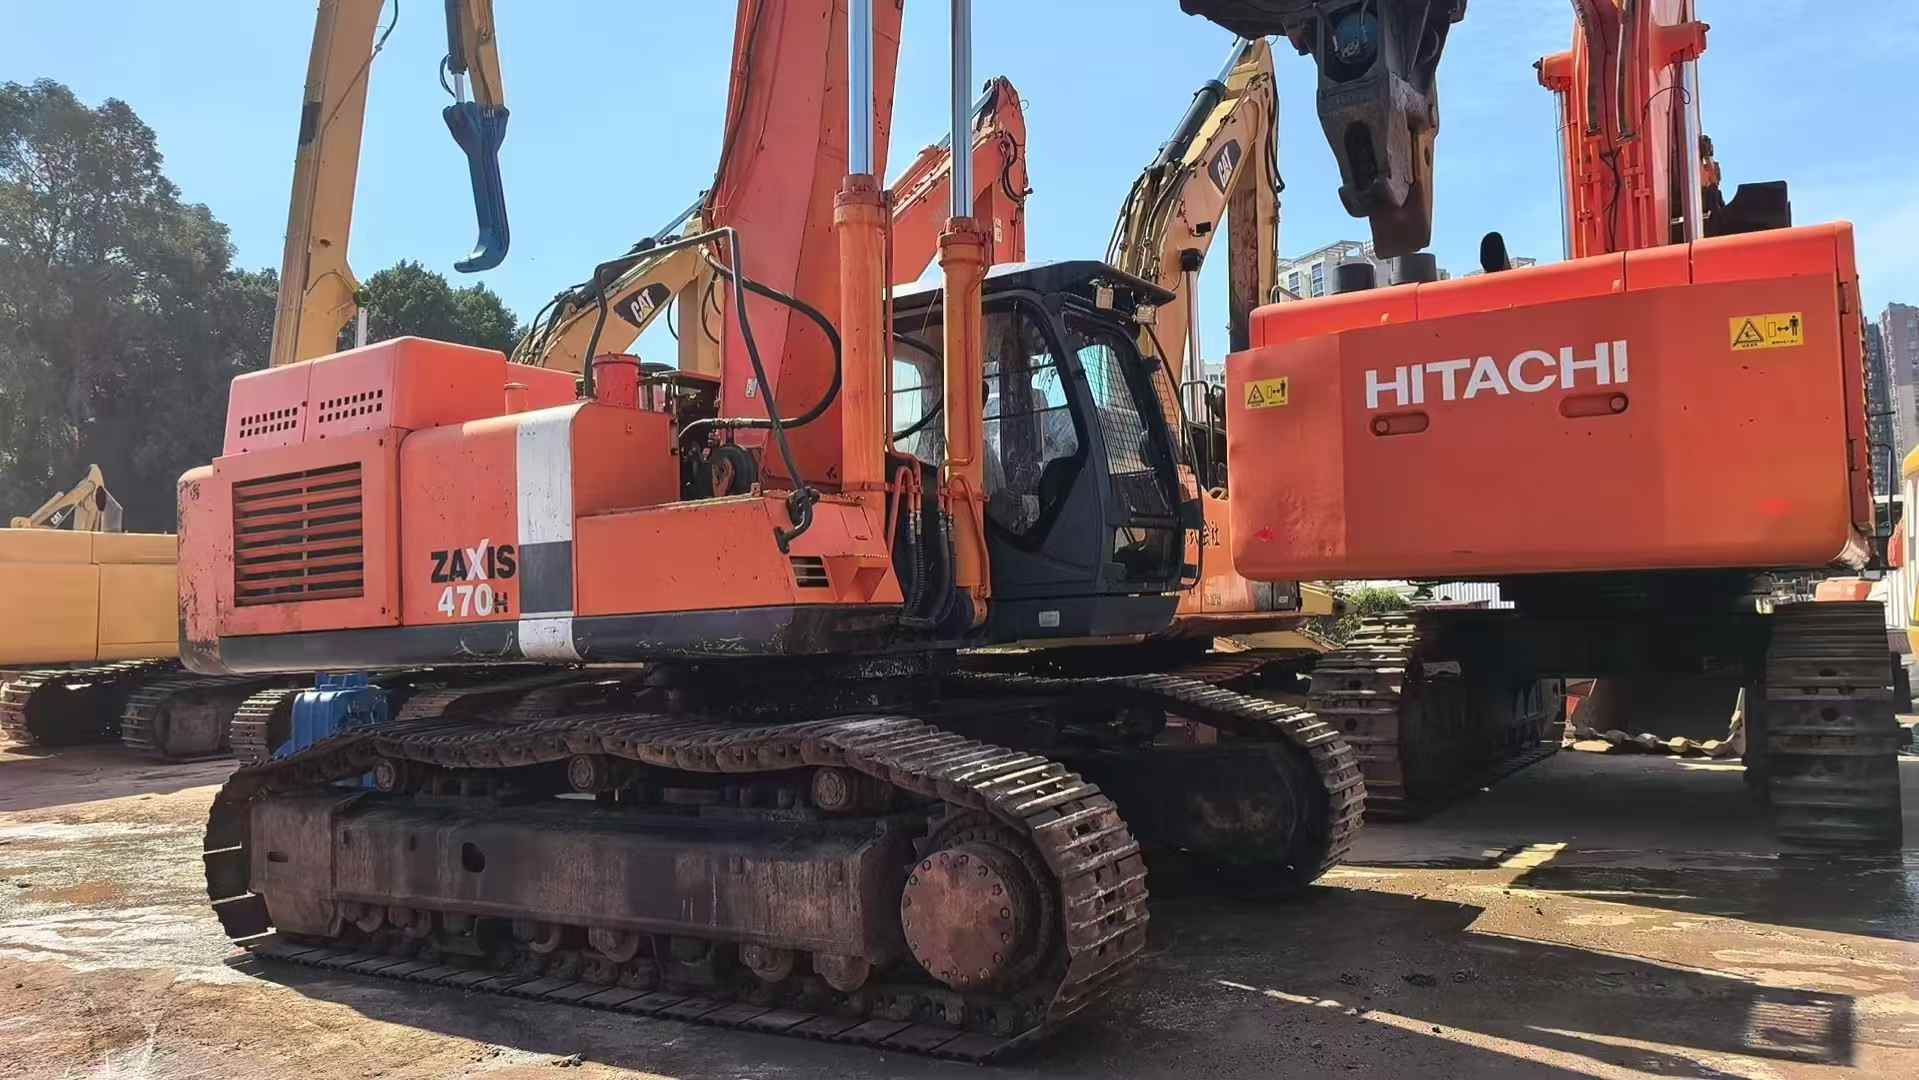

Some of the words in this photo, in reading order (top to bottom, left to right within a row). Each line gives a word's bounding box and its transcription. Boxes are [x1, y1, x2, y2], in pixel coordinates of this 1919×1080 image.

[1217, 145, 1233, 188] CAT
[630, 288, 656, 323] CAT
[1365, 340, 1629, 409] HITACHI
[430, 537, 517, 584] ZAXIS
[438, 583, 508, 617] 470H
